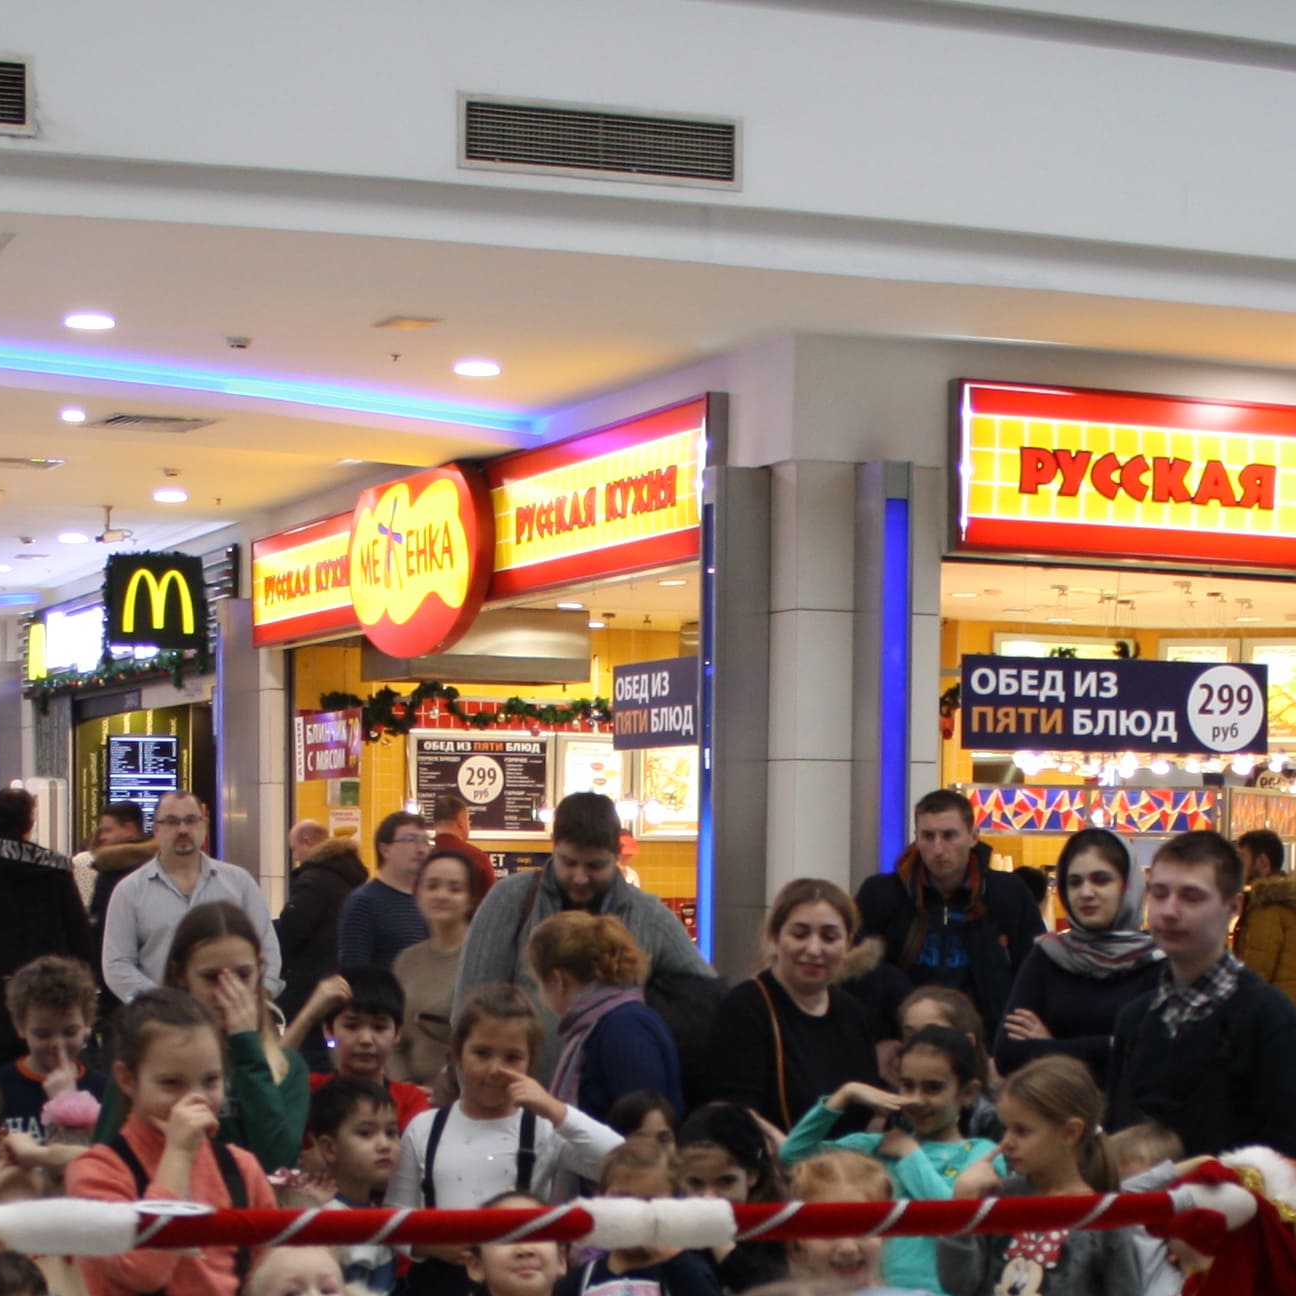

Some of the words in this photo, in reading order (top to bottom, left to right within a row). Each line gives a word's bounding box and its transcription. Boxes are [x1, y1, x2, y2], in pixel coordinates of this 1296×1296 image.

[1017, 445, 1277, 510] РУССКАЯ
[515, 486, 597, 545] РУССКАЯ
[605, 464, 678, 523] КУХНЯ
[264, 565, 311, 606] РУССКАЯ
[615, 673, 649, 705] ОБЕД
[651, 671, 670, 698] ИЗ
[969, 667, 1066, 703] ОБЕД
[1073, 670, 1119, 699] ИЗ
[1197, 683, 1253, 717] 299
[615, 708, 649, 735] ПЯТИ
[650, 704, 694, 737] БЛЮД
[971, 706, 1063, 735] ПЯТИ
[1072, 708, 1178, 744] БЛЮД
[1211, 721, 1239, 743] руб
[423, 741, 455, 752] ОБЕД
[456, 741, 472, 752] ИЗ
[473, 741, 504, 752] ПЯТИ
[505, 742, 541, 753] БЛЮД
[465, 767, 497, 786] 299
[473, 788, 490, 800] руб
